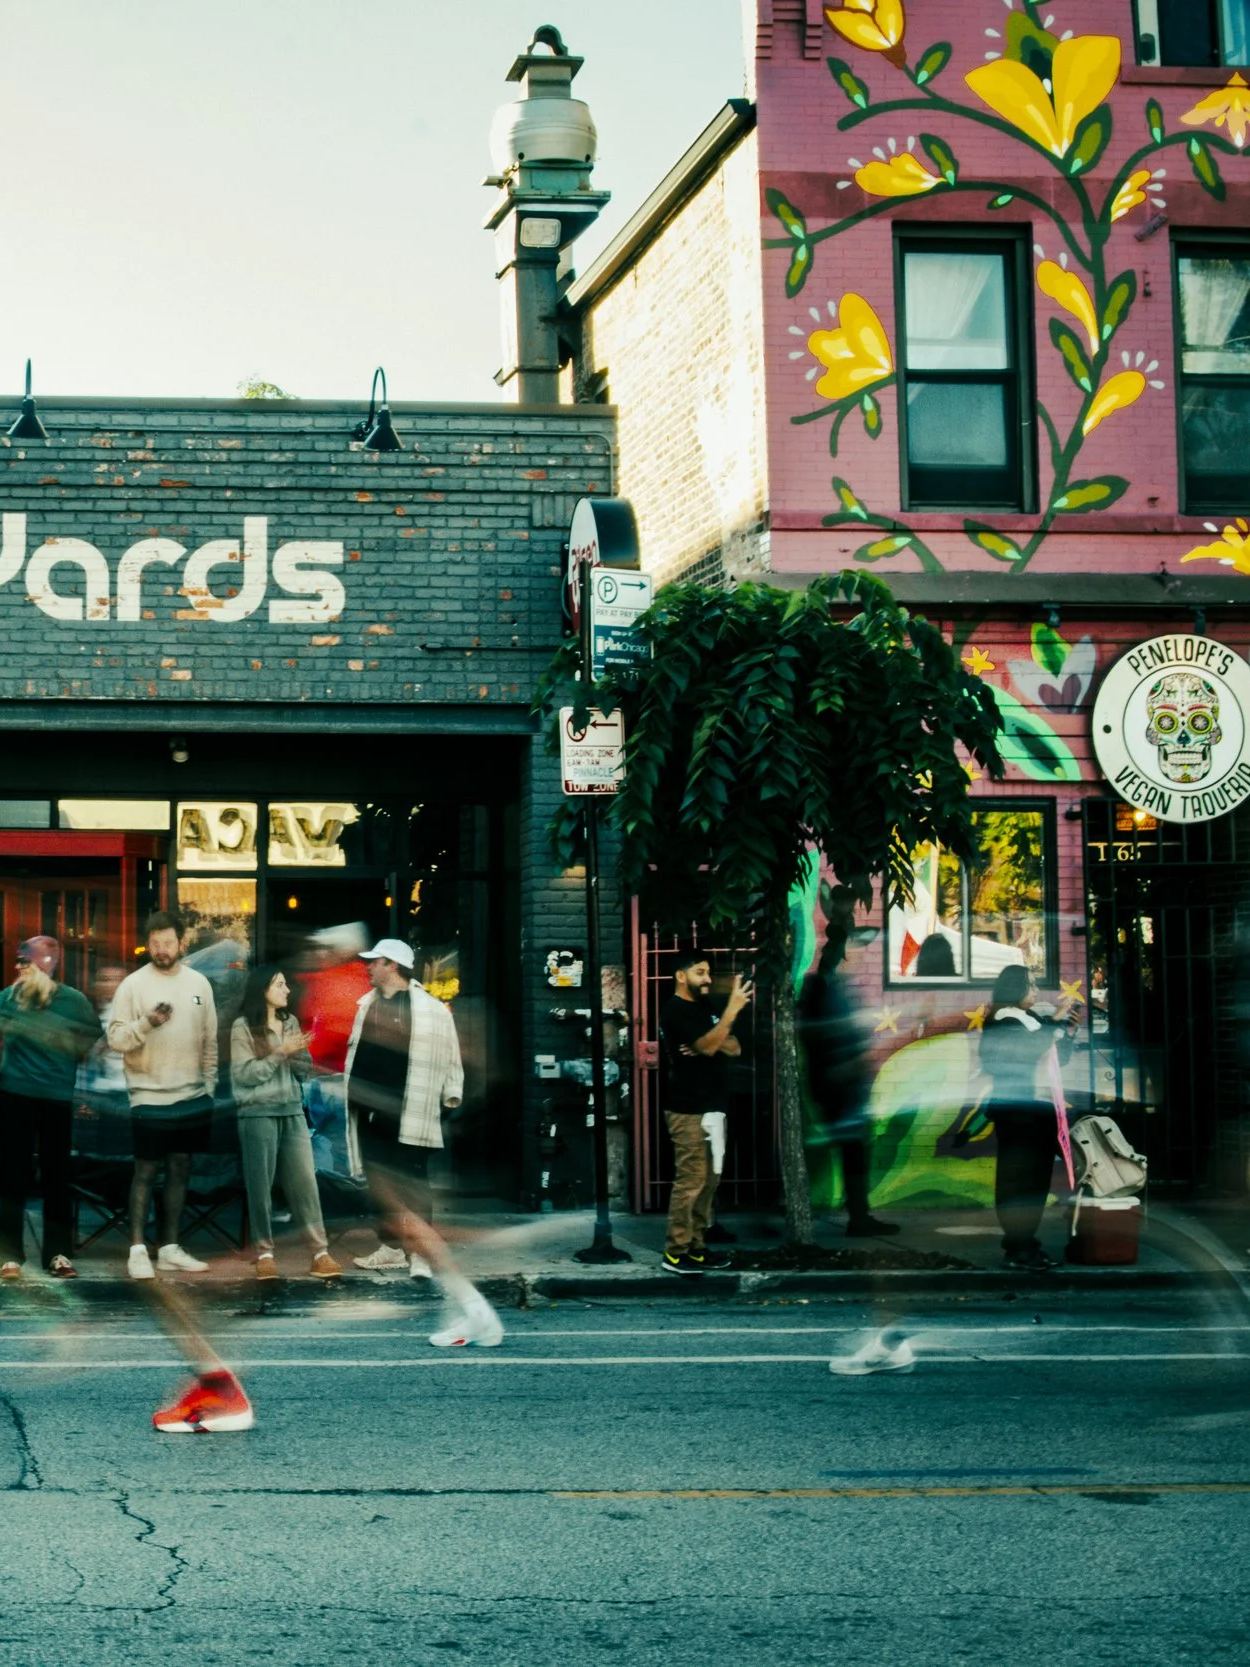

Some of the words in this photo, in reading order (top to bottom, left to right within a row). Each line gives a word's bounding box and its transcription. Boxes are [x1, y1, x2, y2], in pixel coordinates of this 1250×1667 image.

[1126, 638, 1234, 677] PENELOPE'S
[566, 749, 594, 758] LOADING
[598, 749, 615, 758] ZONE
[1114, 765, 1172, 815] VEGAN
